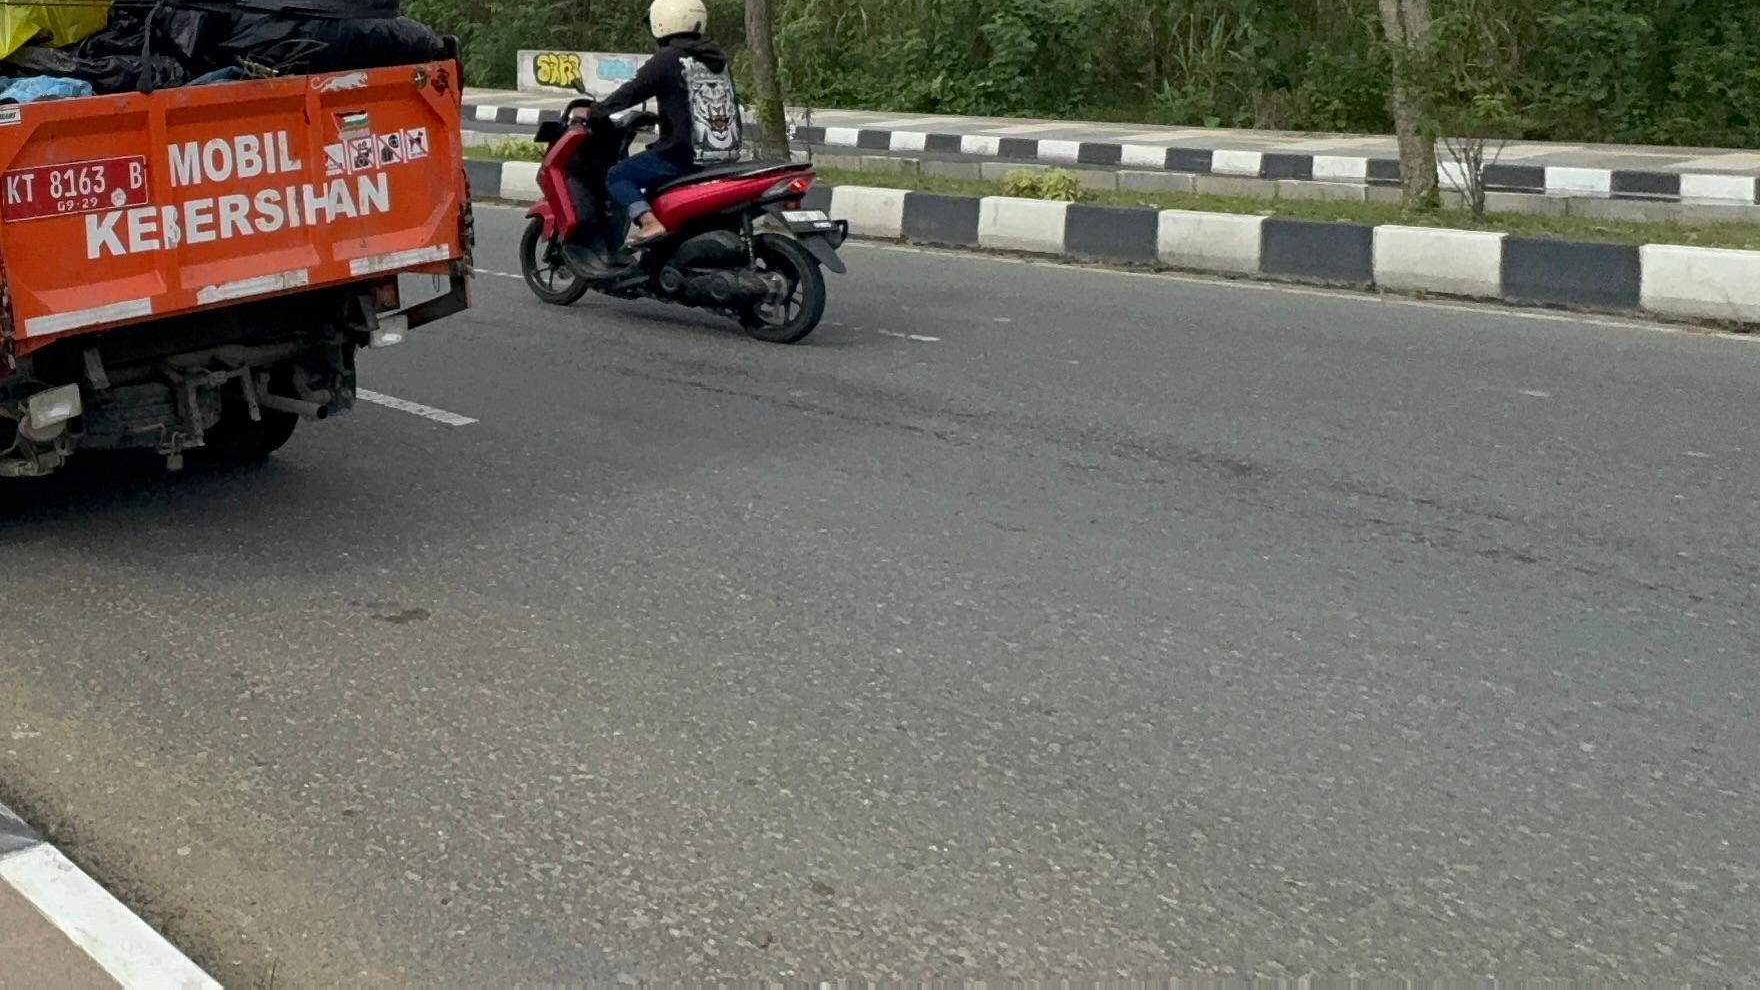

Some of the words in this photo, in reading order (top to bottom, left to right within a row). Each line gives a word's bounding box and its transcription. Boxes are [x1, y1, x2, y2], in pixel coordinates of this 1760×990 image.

[6, 173, 35, 204] KT
[49, 165, 106, 199] 8163
[129, 161, 143, 190] B
[167, 130, 302, 187] MOBIL
[85, 171, 390, 260] KEBERSIHAN
